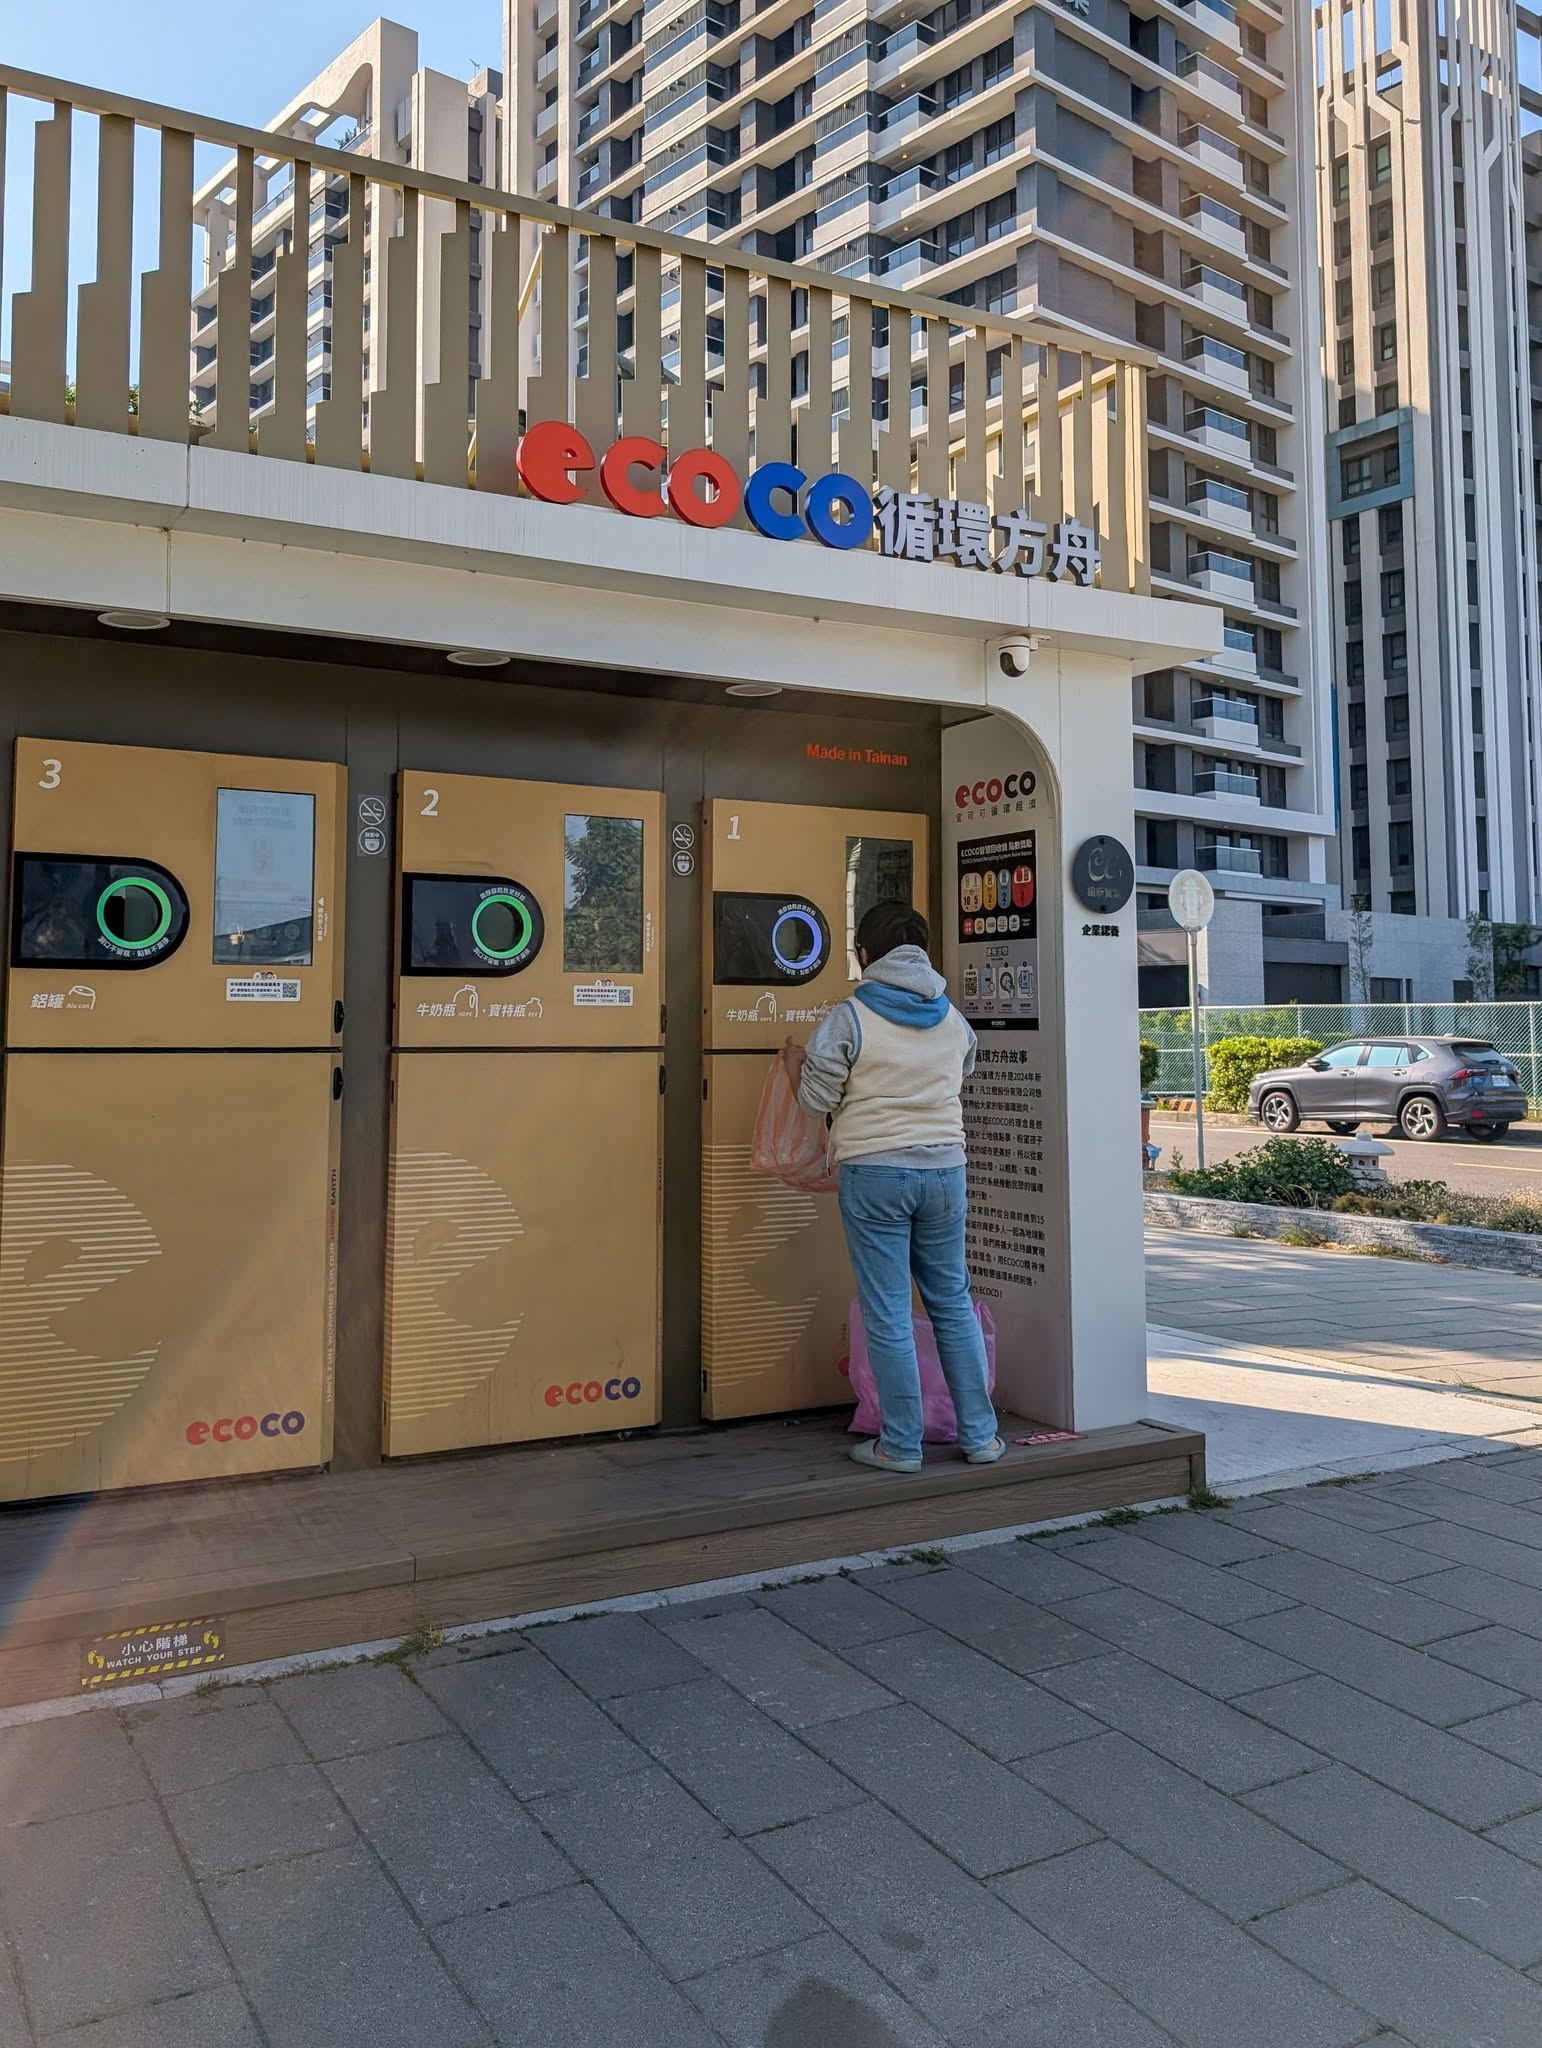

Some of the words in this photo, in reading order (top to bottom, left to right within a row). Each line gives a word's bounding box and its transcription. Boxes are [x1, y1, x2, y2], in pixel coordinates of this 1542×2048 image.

[516, 421, 873, 550] ecoco
[873, 486, 1101, 587] 循環方舟
[806, 743, 845, 760] Made
[864, 749, 908, 766] Tainan
[38, 758, 63, 789] 3
[955, 770, 1036, 809] ecoco
[420, 789, 440, 817] 2
[727, 815, 741, 840] 1
[1081, 924, 1120, 937] 企業認養
[30, 993, 65, 1009] 鋁罐
[416, 1002, 457, 1017] 牛奶瓶
[488, 1004, 527, 1017] 寶特瓶
[726, 1008, 760, 1022] 牛奶瓶
[785, 1009, 816, 1023] 寶特瓶
[543, 1376, 642, 1408] ecoco
[185, 1410, 306, 1446] ecoco
[121, 1633, 189, 1656] 小心階梯
[106, 1656, 142, 1669] WATCH
[147, 1650, 173, 1662] YOUR
[178, 1646, 202, 1657] STEP
